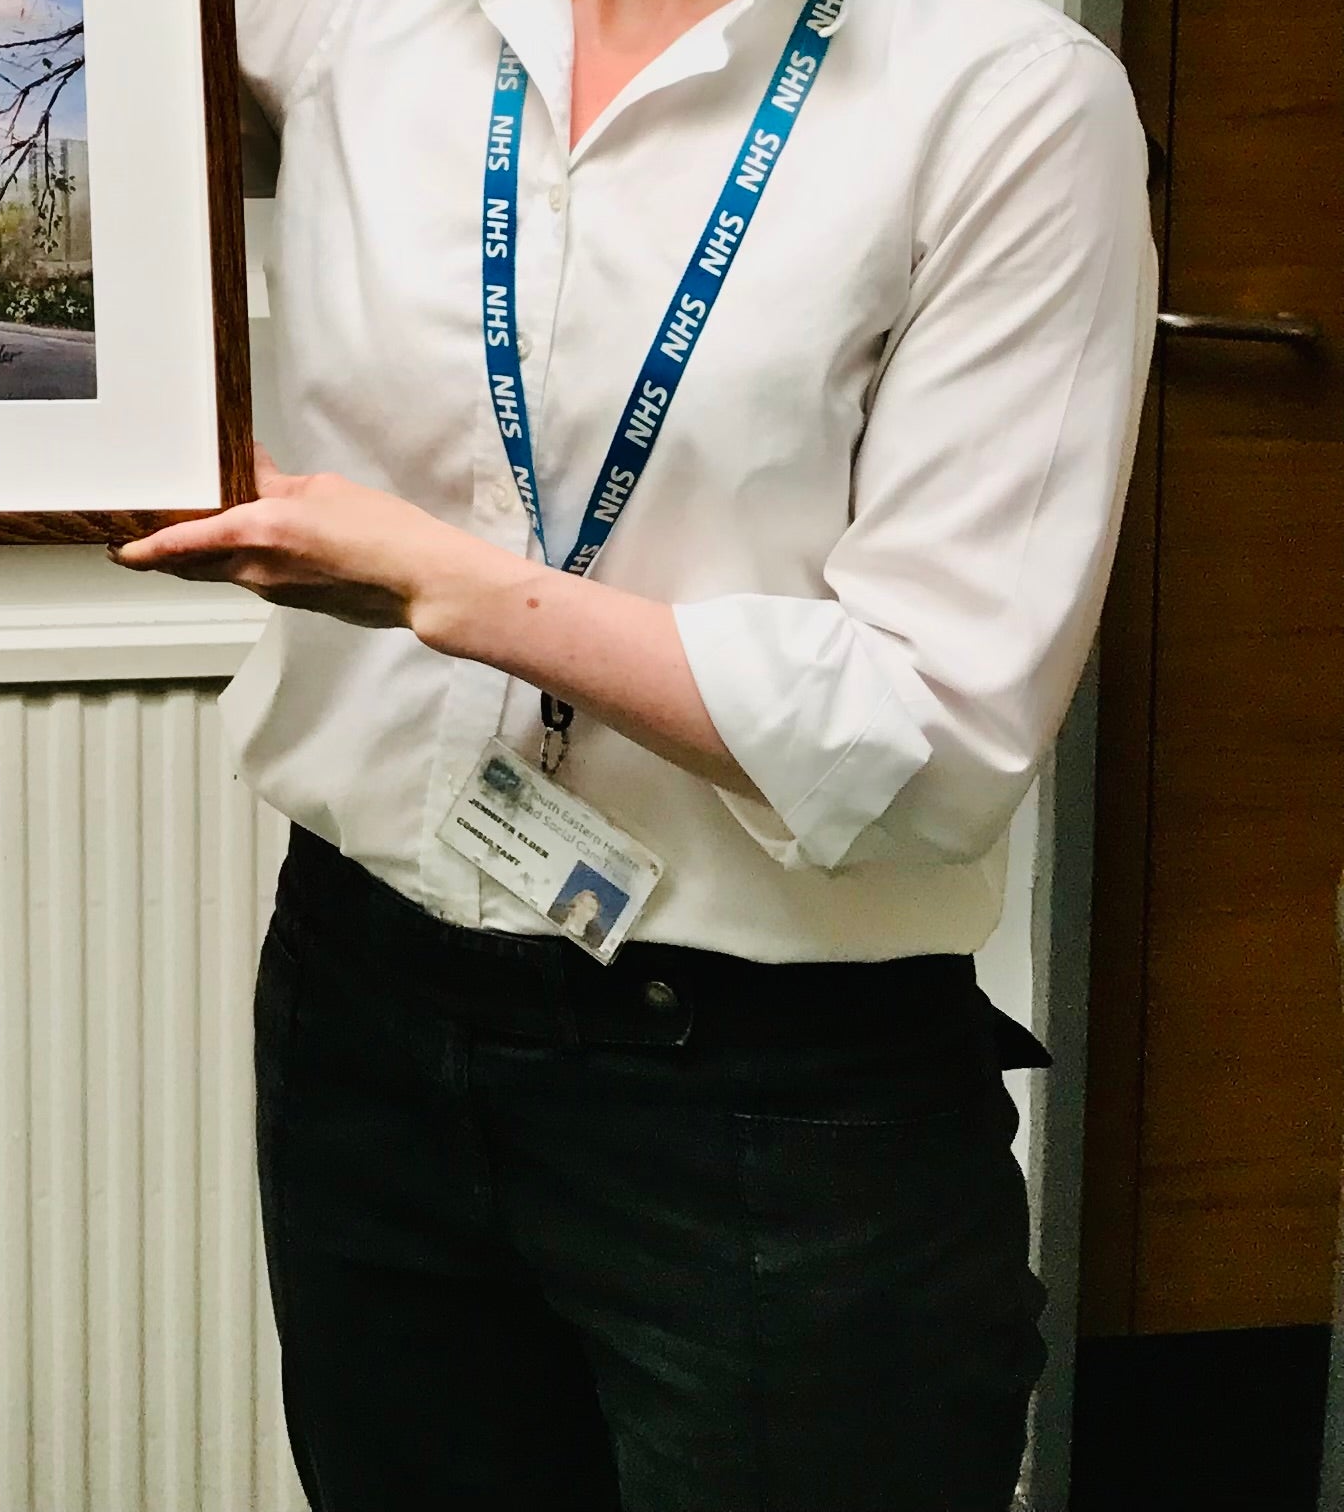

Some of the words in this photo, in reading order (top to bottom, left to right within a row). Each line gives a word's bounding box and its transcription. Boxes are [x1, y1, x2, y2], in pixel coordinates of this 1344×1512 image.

[488, 115, 514, 171] NHS
[485, 198, 509, 259] NHS
[486, 285, 510, 347] NHS
[593, 465, 635, 524] NHS
[624, 379, 668, 449] NHS
[660, 293, 706, 364] NHS
[698, 210, 744, 278] NHS
[735, 128, 780, 193] NHS
[771, 50, 816, 113] NHS
[491, 374, 522, 439] NHS
[517, 832, 549, 859] ELDER
[527, 786, 560, 815] outh
[560, 810, 602, 845] Eastern
